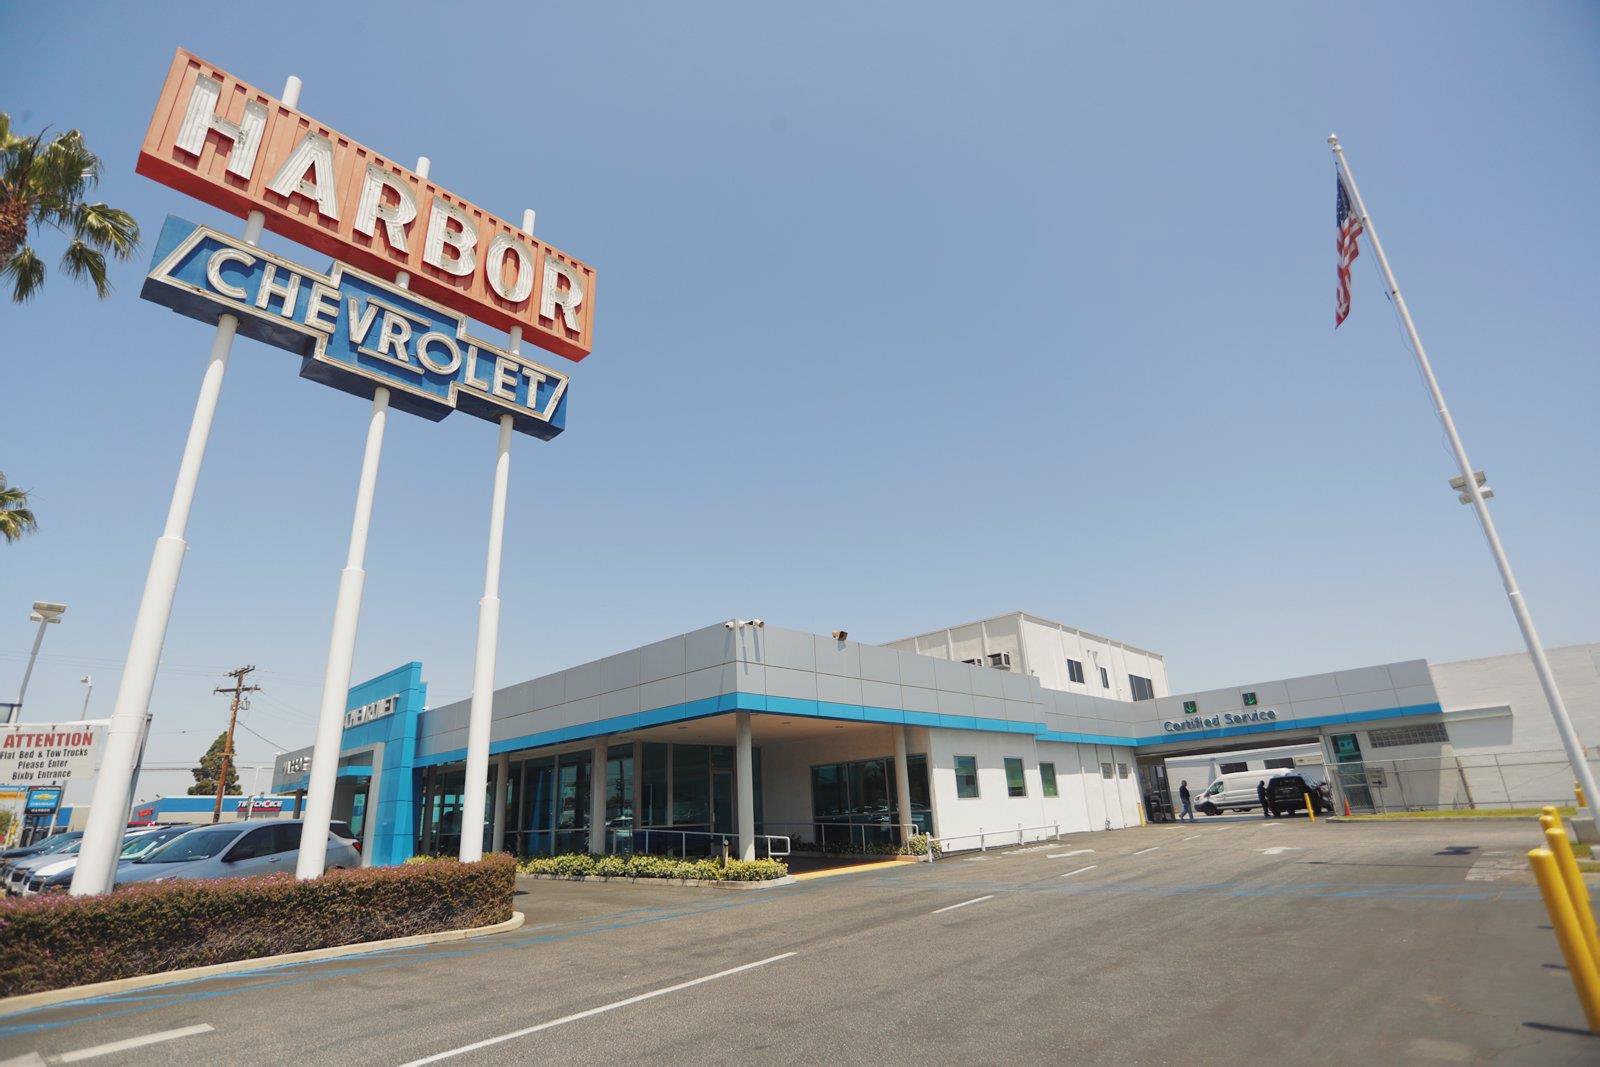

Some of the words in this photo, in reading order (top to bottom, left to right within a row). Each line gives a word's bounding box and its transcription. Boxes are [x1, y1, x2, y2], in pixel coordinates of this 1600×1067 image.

[174, 72, 585, 335] HARBOR
[205, 247, 547, 410] CHEVROLET
[1164, 714, 1220, 732] Certified
[1224, 710, 1276, 725] Service
[3, 732, 94, 749] ATTENTION
[19, 750, 34, 759] Bed
[46, 749, 61, 758] Tow
[63, 748, 88, 757] Trucks
[17, 761, 44, 769] Please
[48, 759, 68, 768] Enter
[12, 771, 34, 781] Bixby
[38, 770, 72, 779] Entrance
